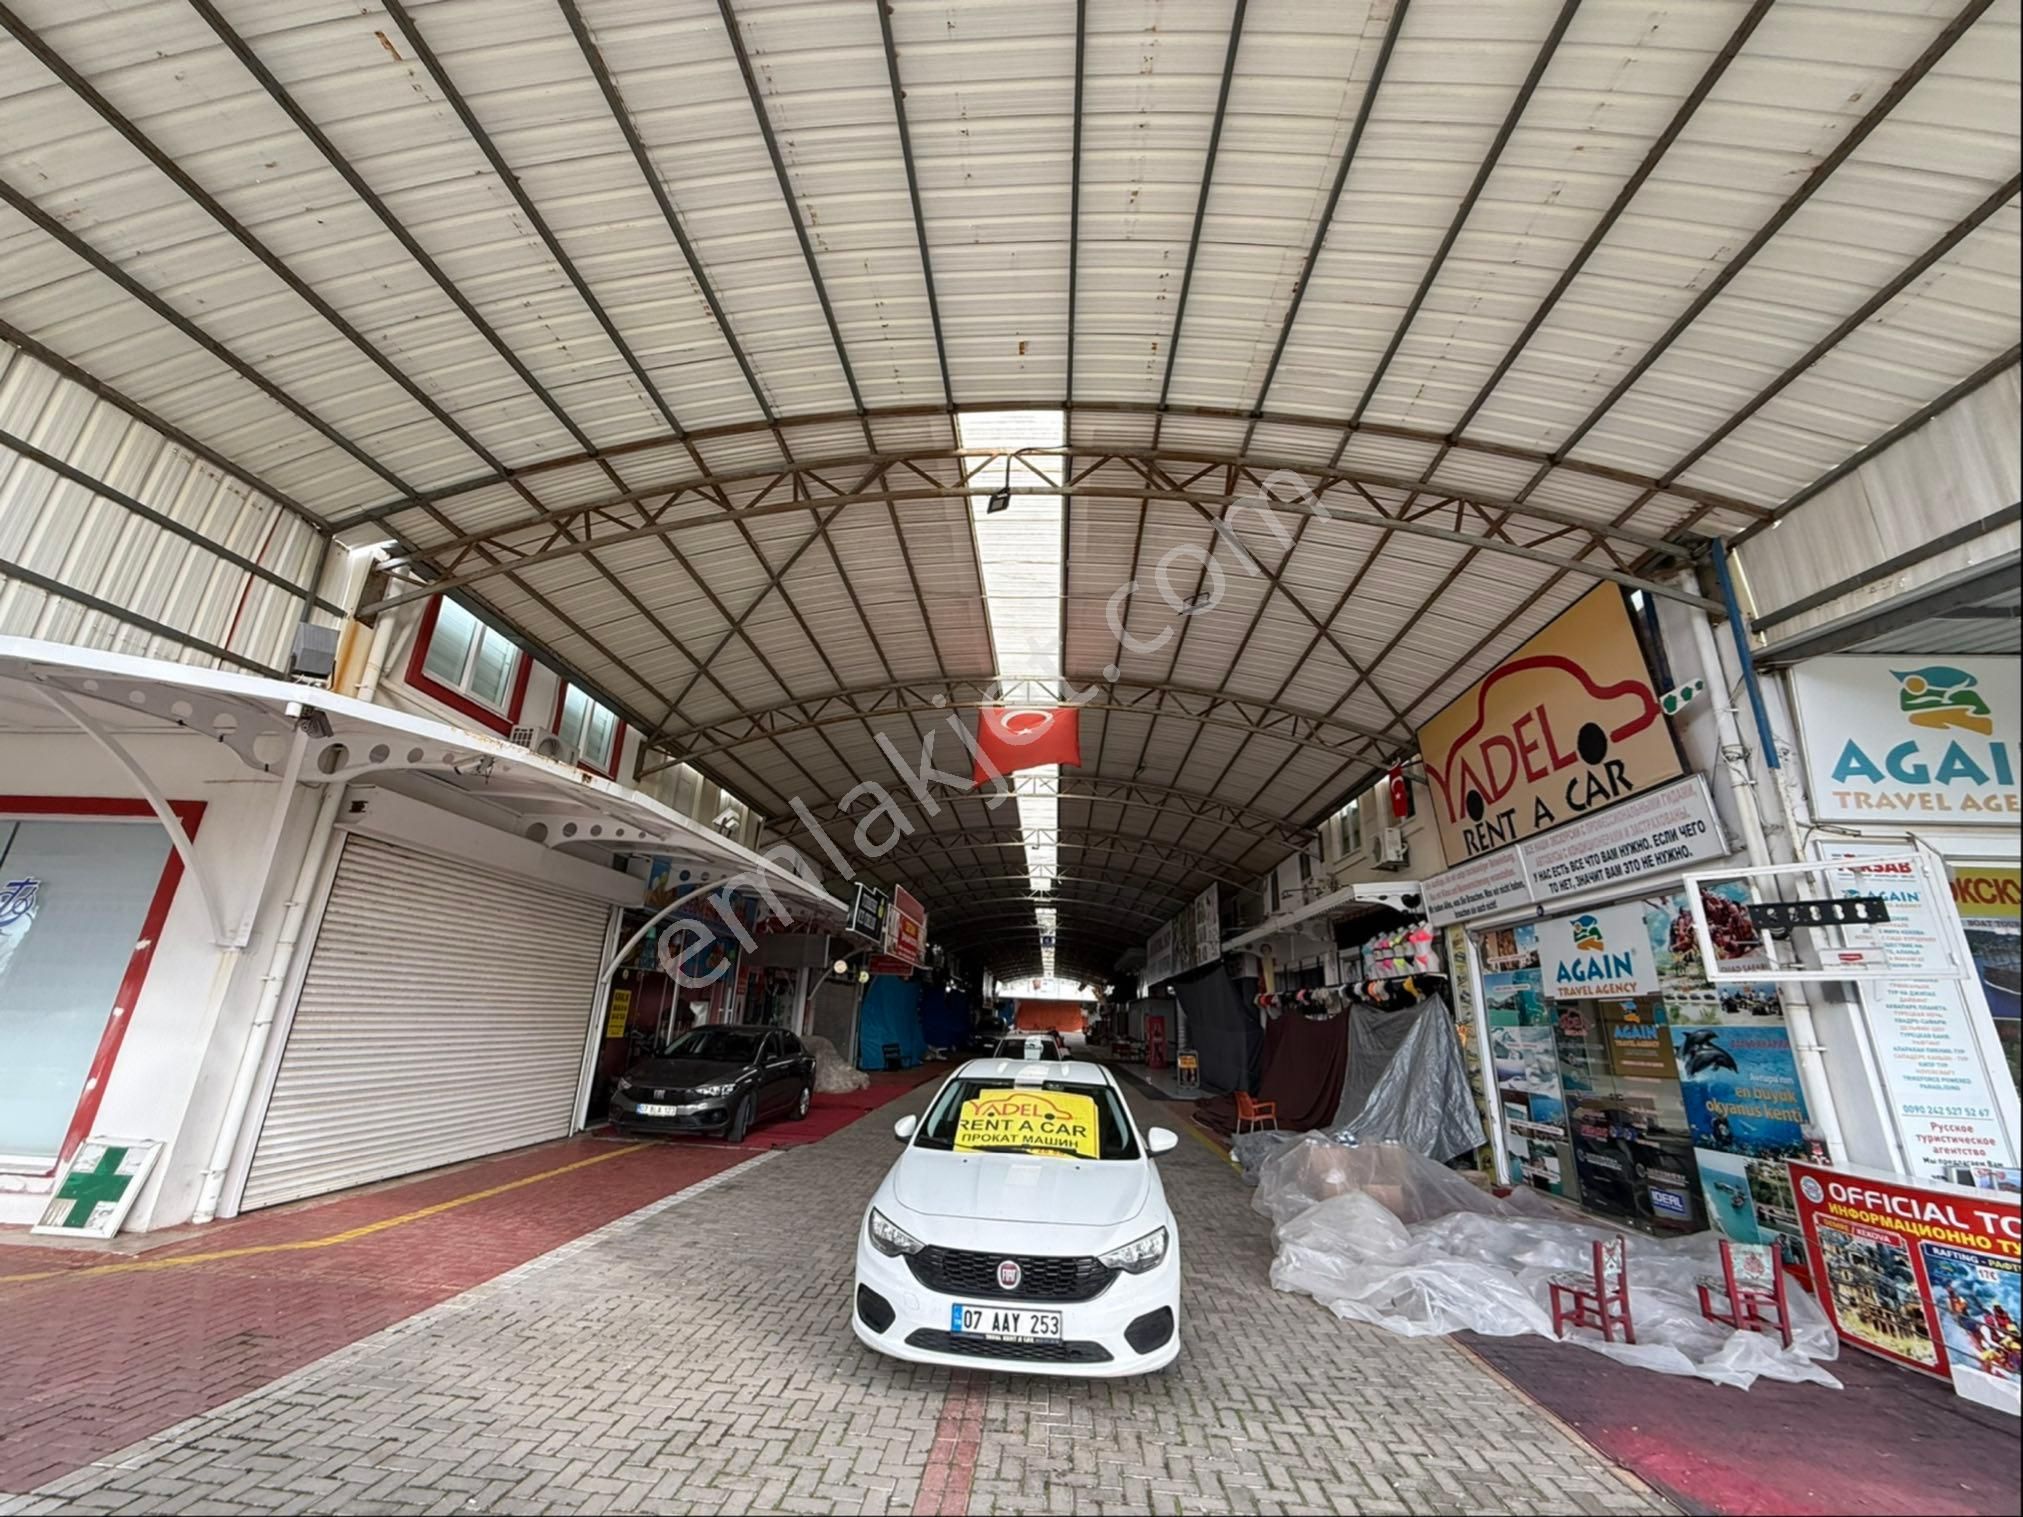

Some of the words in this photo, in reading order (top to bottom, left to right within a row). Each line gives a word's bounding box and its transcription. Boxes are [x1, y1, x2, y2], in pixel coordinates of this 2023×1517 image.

[1425, 703, 1579, 824] YADEL
[1832, 739, 2021, 786] AGAI
[1463, 808, 1518, 857] RENT
[1534, 796, 1555, 829] A
[1566, 759, 1634, 812] CAR
[1833, 791, 1952, 811] TRAVEL
[1532, 872, 1539, 882] У
[1537, 868, 1552, 881] НАС
[1551, 862, 1569, 877] ЕСТЬ
[1569, 858, 1584, 871] ВСЕ
[1584, 853, 1601, 867] ЧТО
[1599, 847, 1619, 862] ВАМ
[1618, 837, 1653, 857] НУЖНО.
[1652, 829, 1679, 847] ЕСЛИ
[1678, 820, 1707, 840] ЧЕГО
[1548, 881, 1559, 893] ТО
[1557, 877, 1575, 891] НЕТ,
[1574, 869, 1605, 886] ЗНАЧИТ
[1604, 864, 1623, 879] ВАМ
[1622, 859, 1641, 874] ЭТО
[1640, 855, 1655, 869] НЕ
[1654, 844, 1693, 866] НУЖНО.
[1557, 952, 1633, 983] AGAIN
[1558, 985, 1595, 997] TRAVEL
[1595, 982, 1638, 994] AGENCY
[1614, 1024, 1658, 1040] AGAIN
[1735, 1086, 1751, 1098] en
[970, 1101, 1042, 1118] YADEL
[1706, 1097, 1761, 1118] okyanus
[960, 1119, 1013, 1131] RENT
[1019, 1122, 1034, 1132] A
[1040, 1123, 1087, 1138] CAR
[1930, 1121, 1974, 1133] Русское
[961, 1133, 1019, 1143] ПРОКАТ
[1022, 1135, 1079, 1148] МАШИН
[1916, 1134, 1996, 1146] туристическое
[1933, 1147, 1986, 1156] агентство
[1828, 1182, 1970, 1230] OFFICIAL
[1828, 1202, 1992, 1250] ИНФОРМАЦИОННО
[1932, 1247, 1979, 1264] RAFTING
[963, 1309, 982, 1330] 07
[992, 1311, 1020, 1333] AAY
[1031, 1314, 1059, 1335] 253
